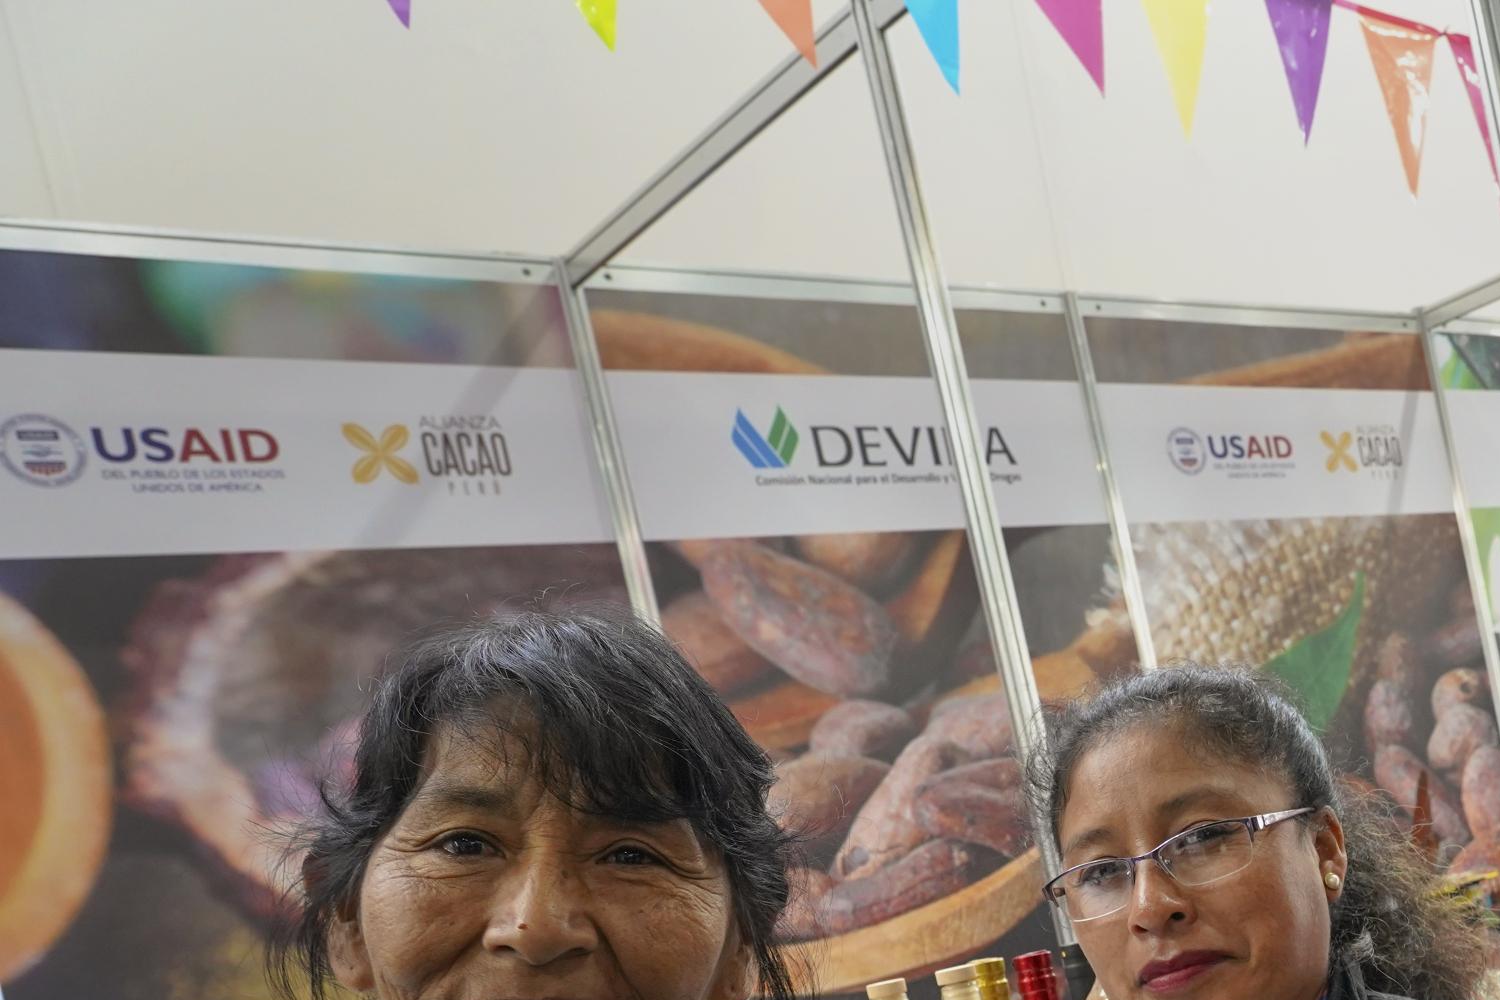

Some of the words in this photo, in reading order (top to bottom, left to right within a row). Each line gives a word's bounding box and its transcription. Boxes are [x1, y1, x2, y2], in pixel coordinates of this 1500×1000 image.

[89, 426, 279, 463] USAID
[421, 432, 512, 476] CACAO
[810, 426, 1018, 467] DEVIA
[1207, 436, 1292, 460] USAID
[1357, 437, 1403, 466] CACAO
